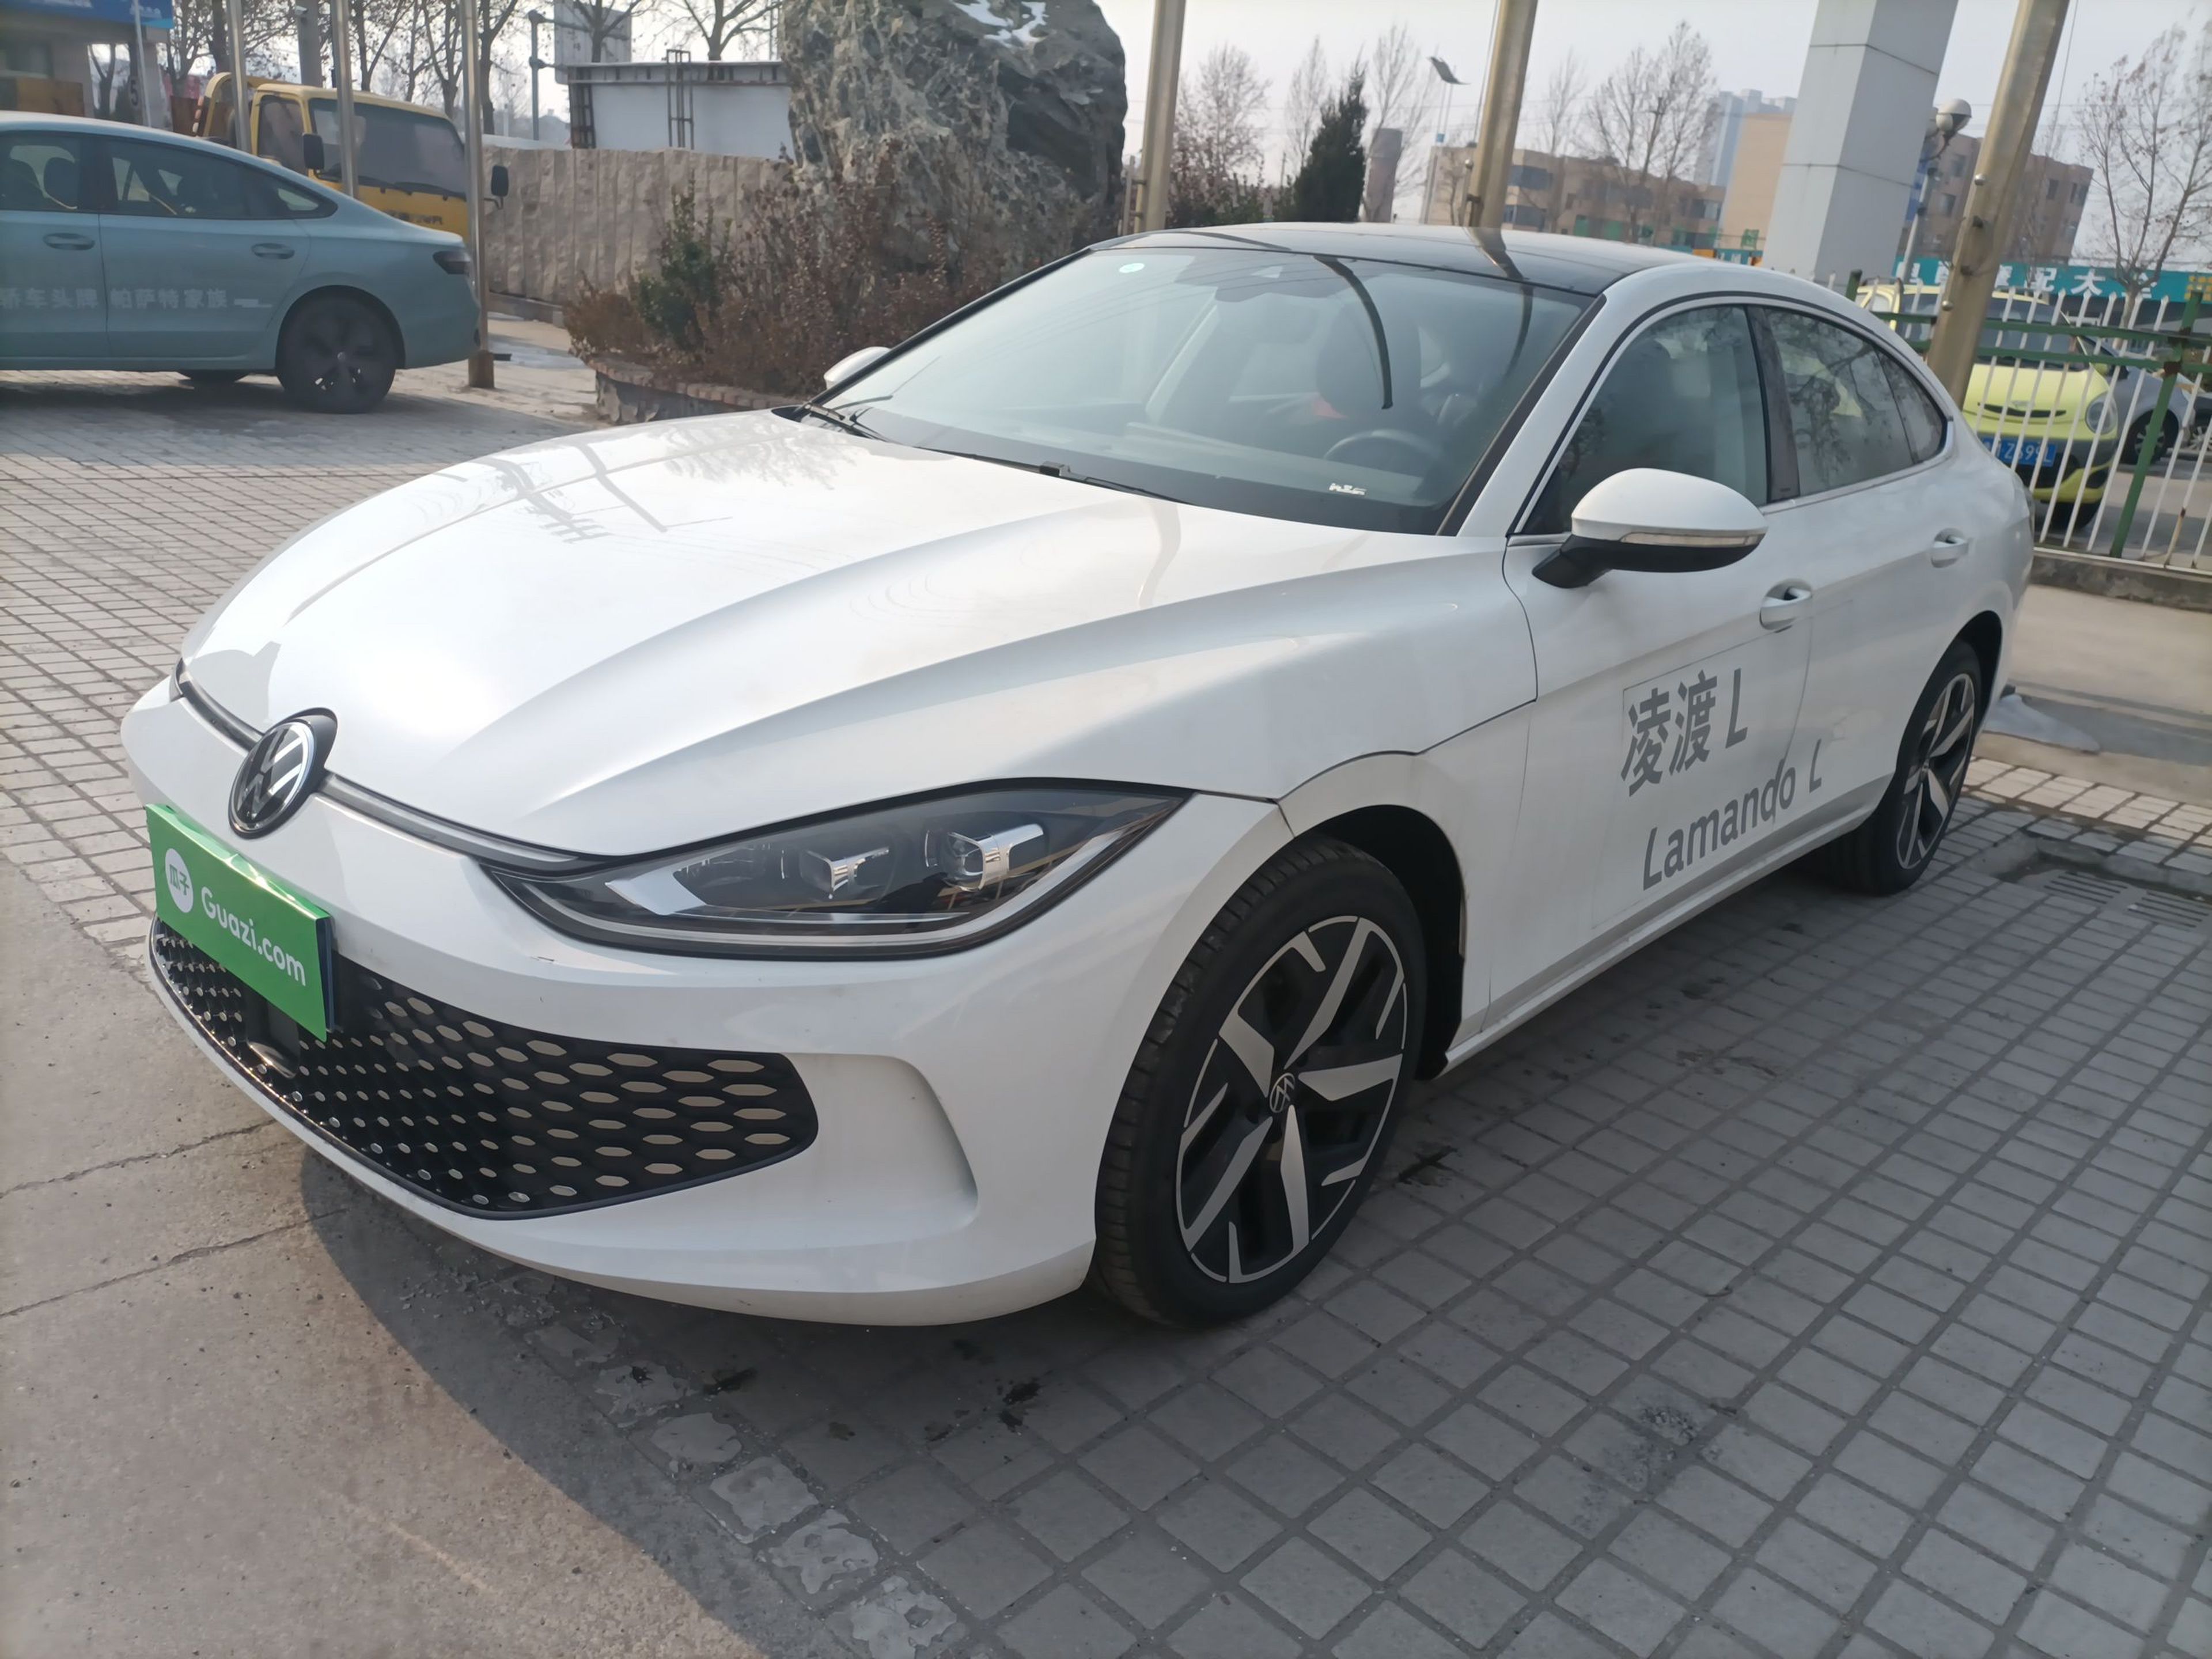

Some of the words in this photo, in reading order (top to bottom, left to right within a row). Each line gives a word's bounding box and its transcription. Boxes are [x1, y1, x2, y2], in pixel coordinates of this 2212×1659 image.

[111, 288, 226, 309] 帕萨特家族
[1621, 669, 1718, 797] 凌渡
[1725, 668, 1748, 749] L
[1643, 758, 1796, 891] Lamando
[1809, 738, 1823, 793] L
[170, 864, 190, 896] 瓜子
[201, 887, 306, 987] Guazi.com
